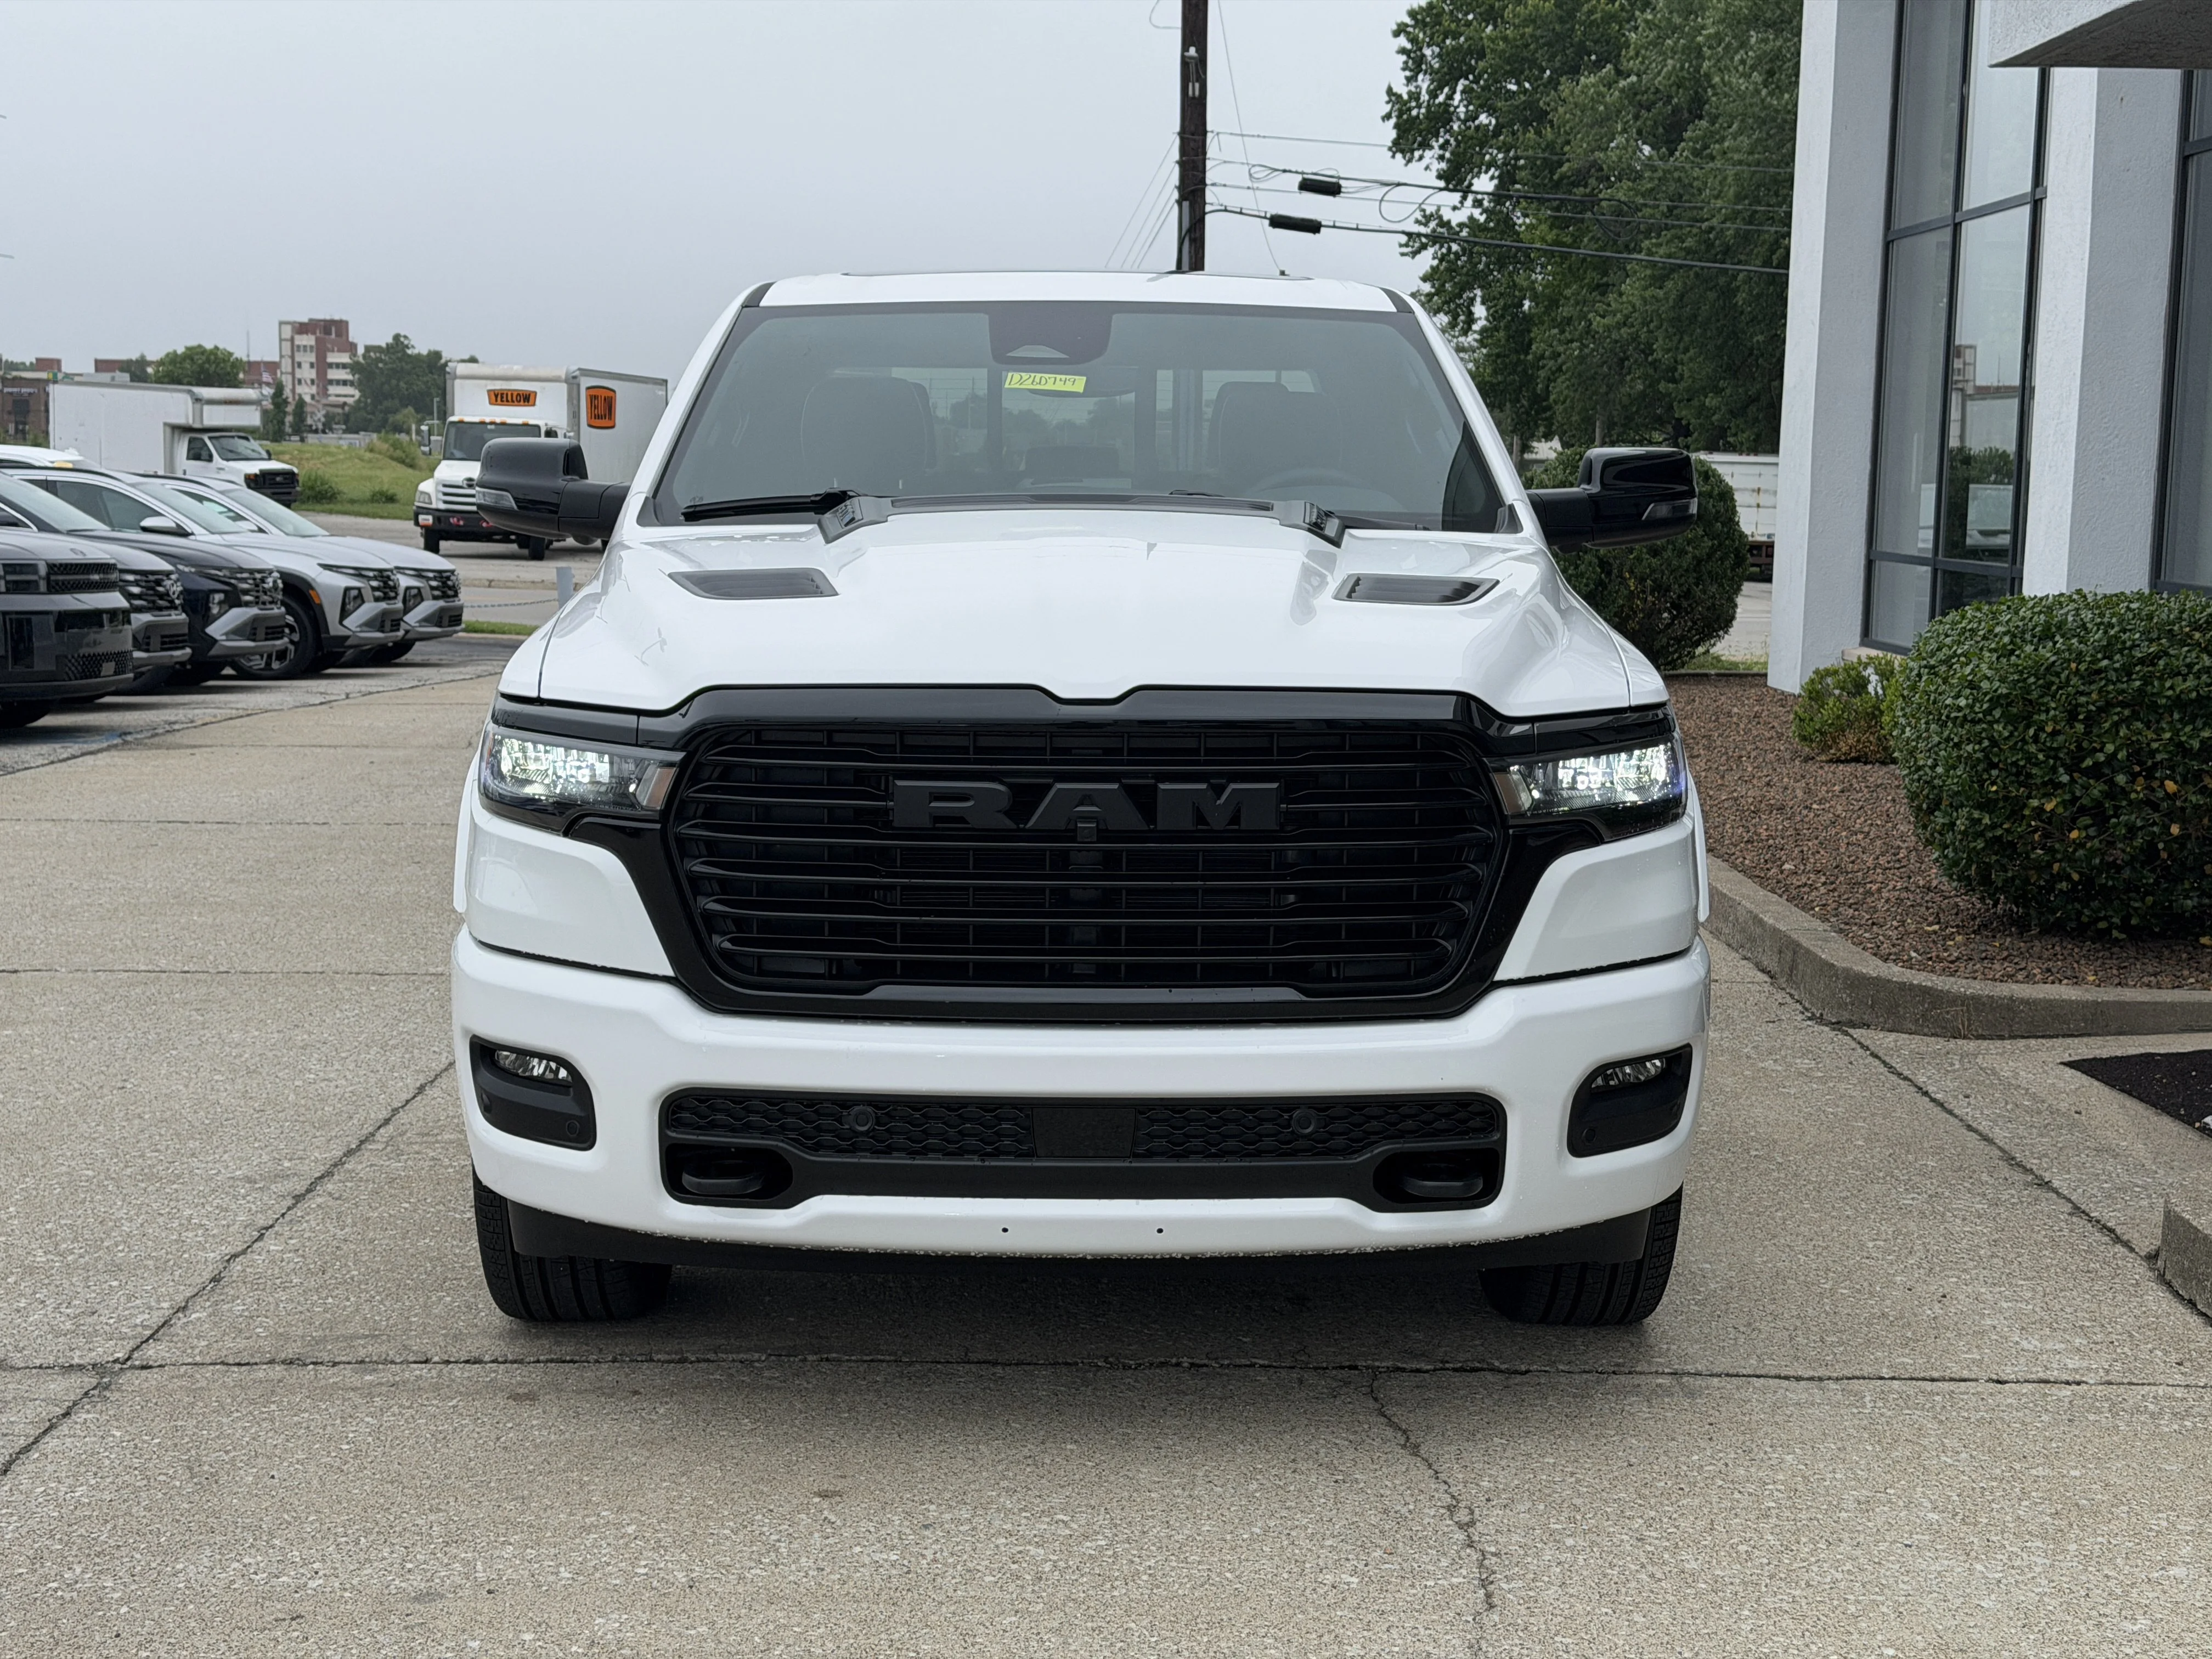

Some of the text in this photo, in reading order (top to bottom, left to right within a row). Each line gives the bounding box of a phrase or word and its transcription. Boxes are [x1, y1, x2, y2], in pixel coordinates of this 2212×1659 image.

[493, 391, 531, 404] YELLOW
[589, 394, 613, 421] YELLOW
[893, 780, 1280, 830] RAM
